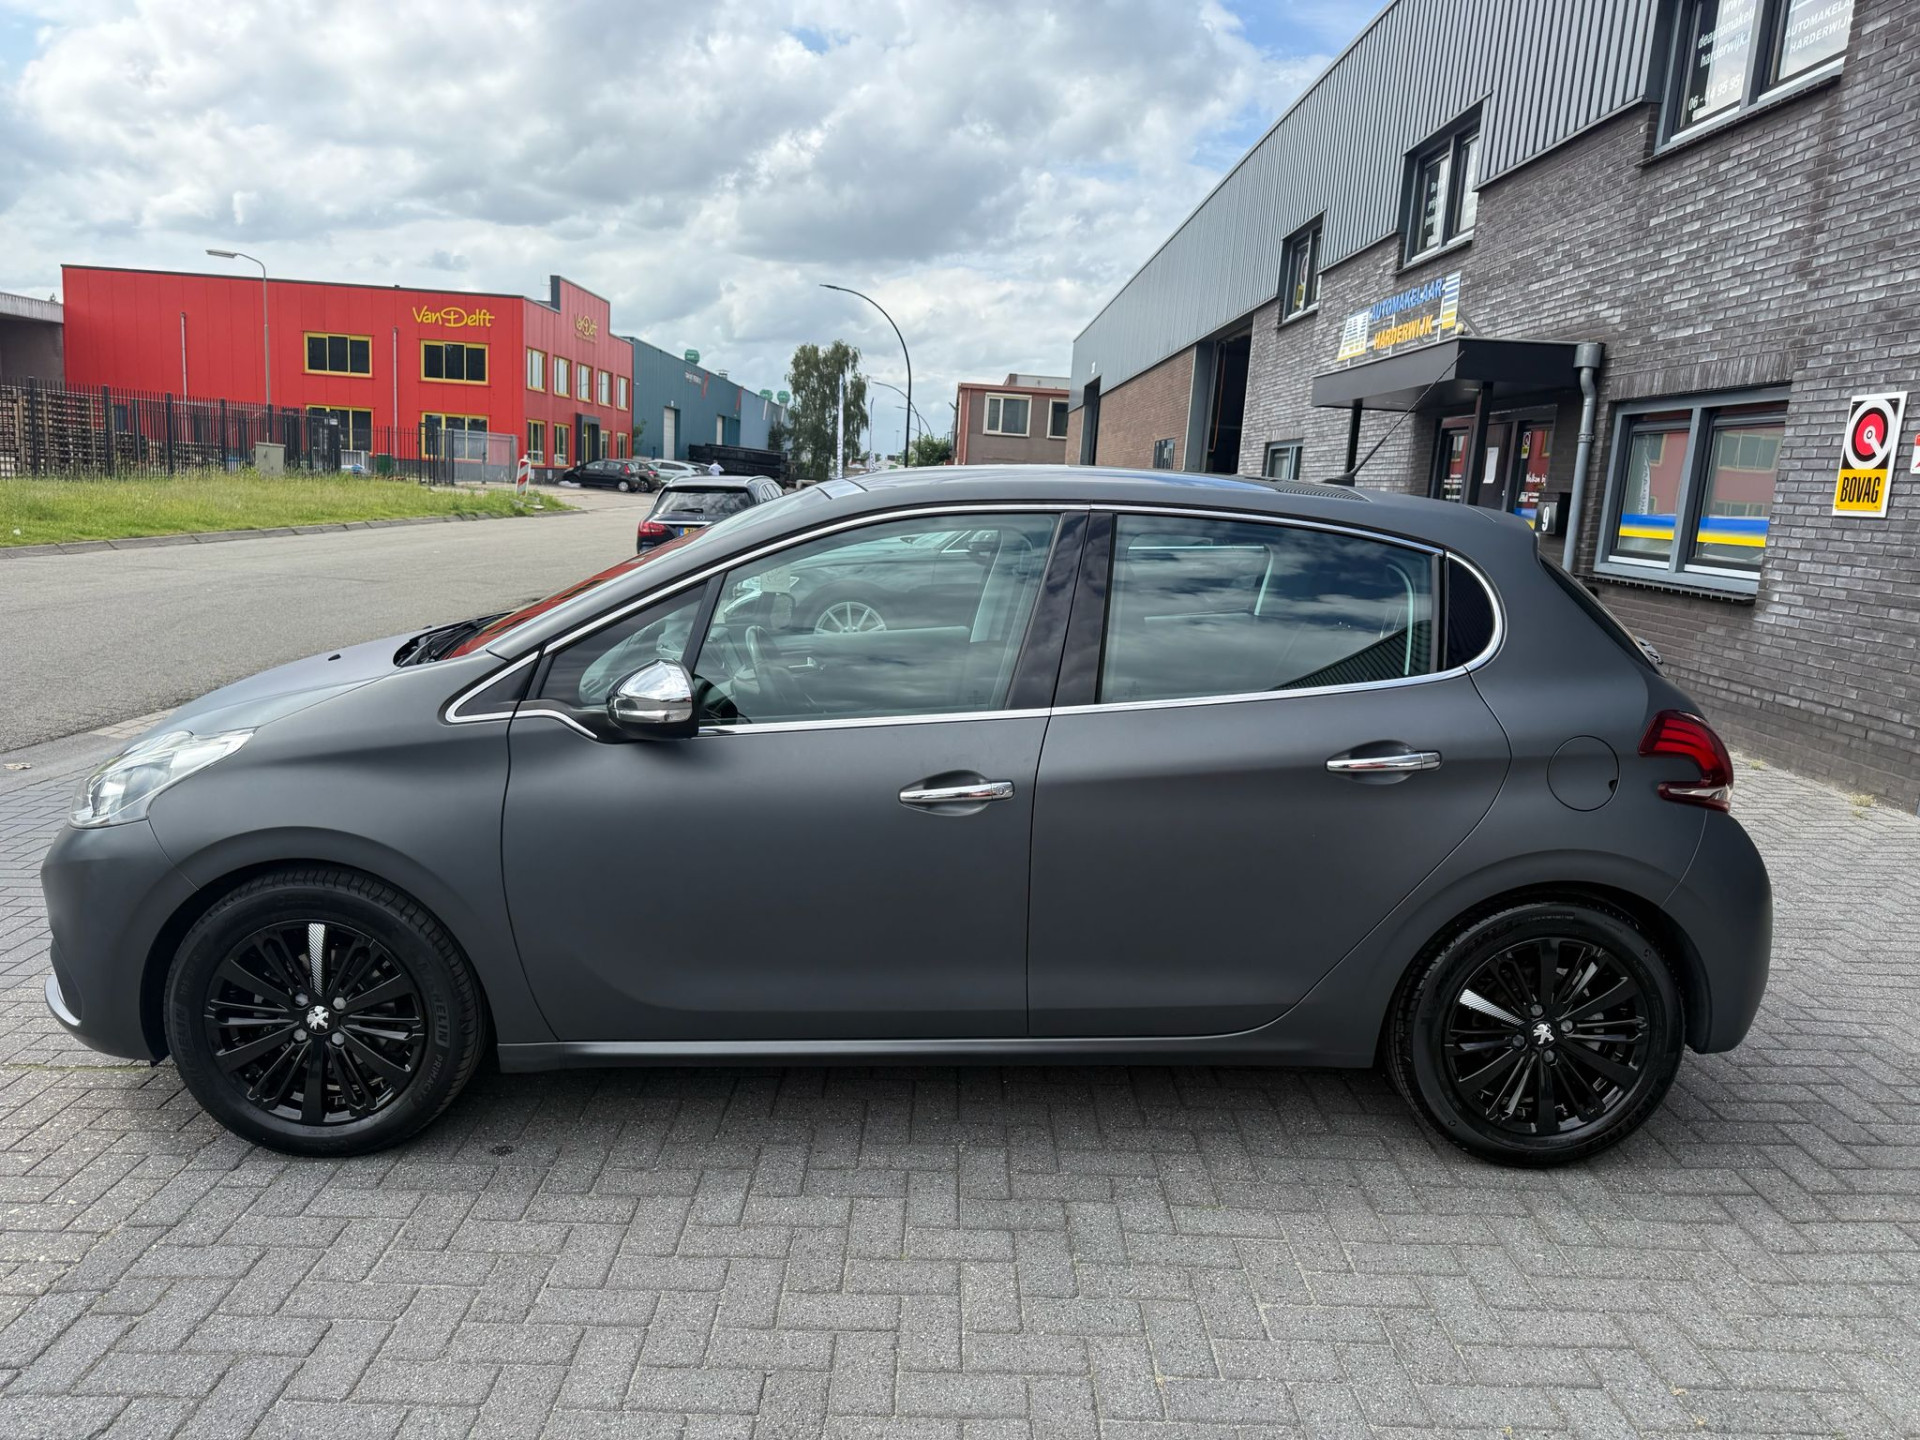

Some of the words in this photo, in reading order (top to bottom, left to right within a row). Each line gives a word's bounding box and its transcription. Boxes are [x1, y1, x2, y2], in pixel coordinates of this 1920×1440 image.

[1370, 278, 1443, 322] AUTOMAKELAAR
[1373, 314, 1434, 350] HARDERWIJK
[1840, 477, 1881, 503] BOVAG
[1541, 506, 1550, 532] 9
